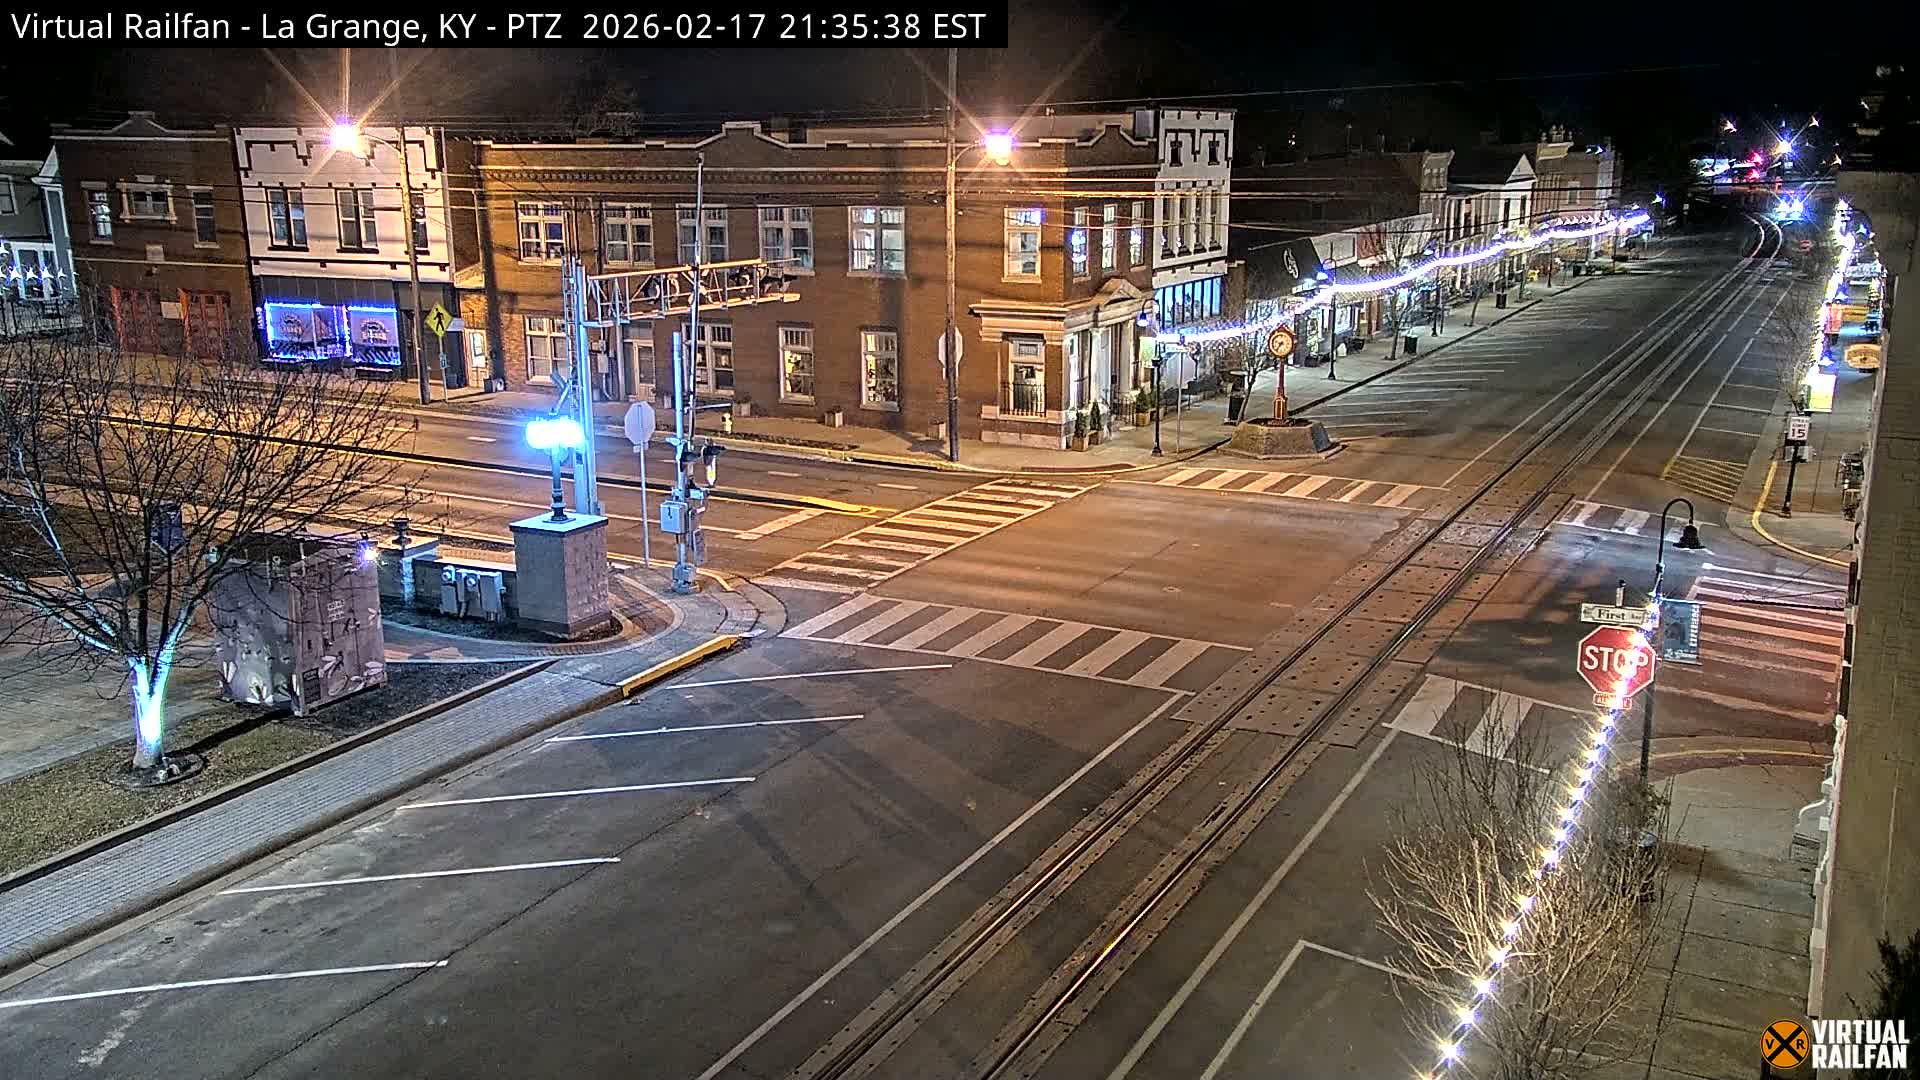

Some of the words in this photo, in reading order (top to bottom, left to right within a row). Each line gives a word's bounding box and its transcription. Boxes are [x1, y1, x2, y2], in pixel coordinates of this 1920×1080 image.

[1791, 428, 1806, 438] 15
[1597, 609, 1626, 620] First
[1583, 645, 1649, 676] STOP
